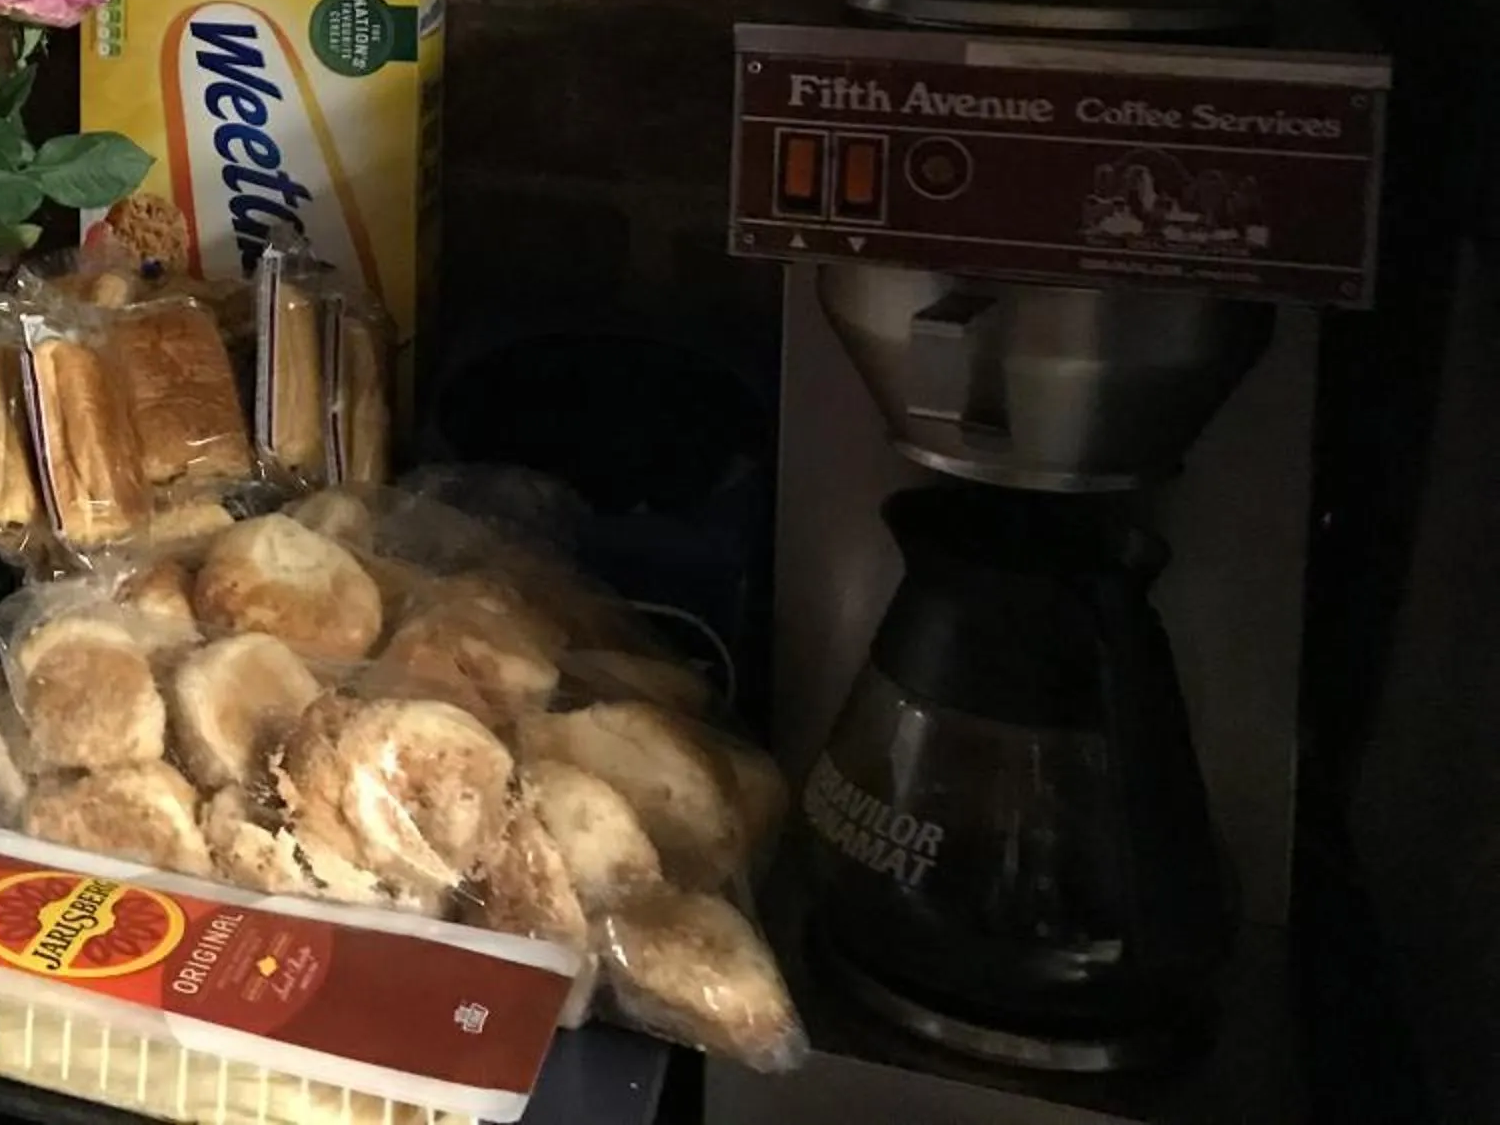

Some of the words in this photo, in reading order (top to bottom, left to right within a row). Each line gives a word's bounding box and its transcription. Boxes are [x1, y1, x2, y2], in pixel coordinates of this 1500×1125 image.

[787, 73, 892, 113] Fifth
[900, 80, 1055, 123] Avenue
[1075, 96, 1183, 129] Coffee
[1190, 102, 1342, 139] Services
[190, 21, 338, 280] Weeta
[172, 912, 244, 995] ORIGINAL
